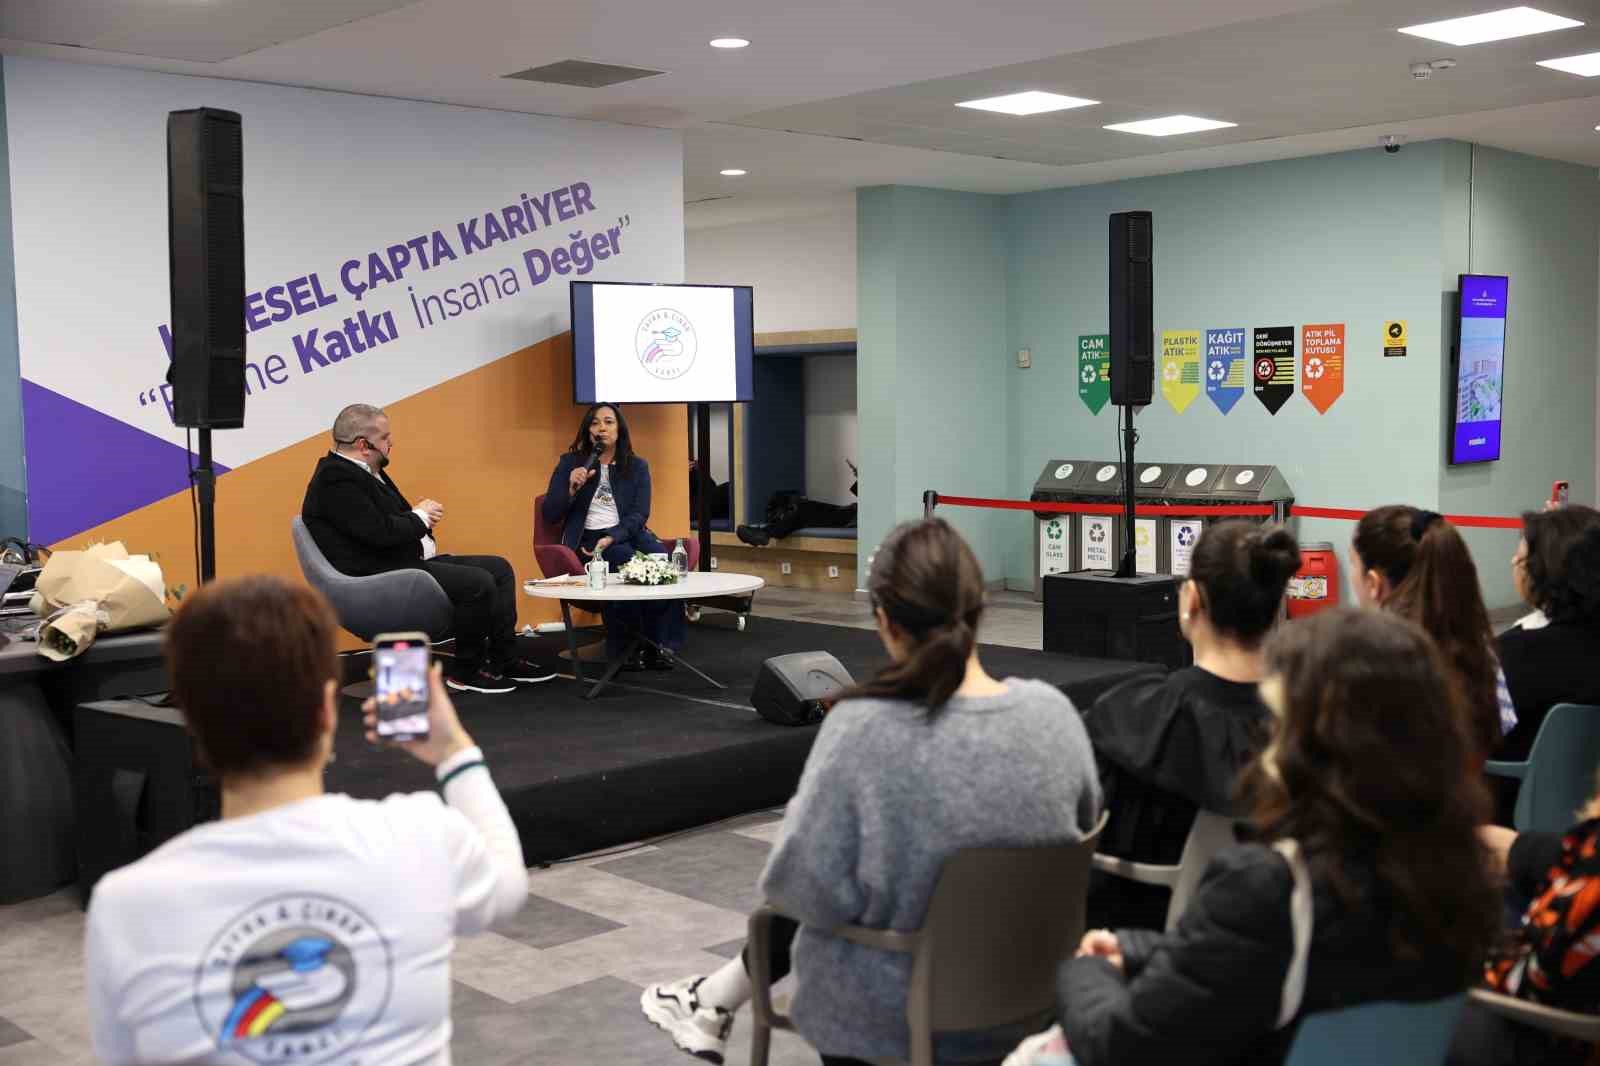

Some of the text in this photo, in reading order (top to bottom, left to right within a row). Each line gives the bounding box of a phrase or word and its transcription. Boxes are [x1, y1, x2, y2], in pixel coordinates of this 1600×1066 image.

[158, 181, 597, 363] ESEL ÇAPTA KARİYER
[292, 214, 631, 375] Katkı İnsana Değer”
[1324, 328, 1336, 336] PİL
[1163, 336, 1198, 345] PLASTİK
[1208, 331, 1244, 344] KAĞIT
[1305, 338, 1341, 346] TOPLAMA
[1081, 339, 1104, 349] CAM
[1163, 347, 1184, 356] ATIK
[1208, 346, 1230, 355] ATIK
[1081, 351, 1100, 360] ATIK
